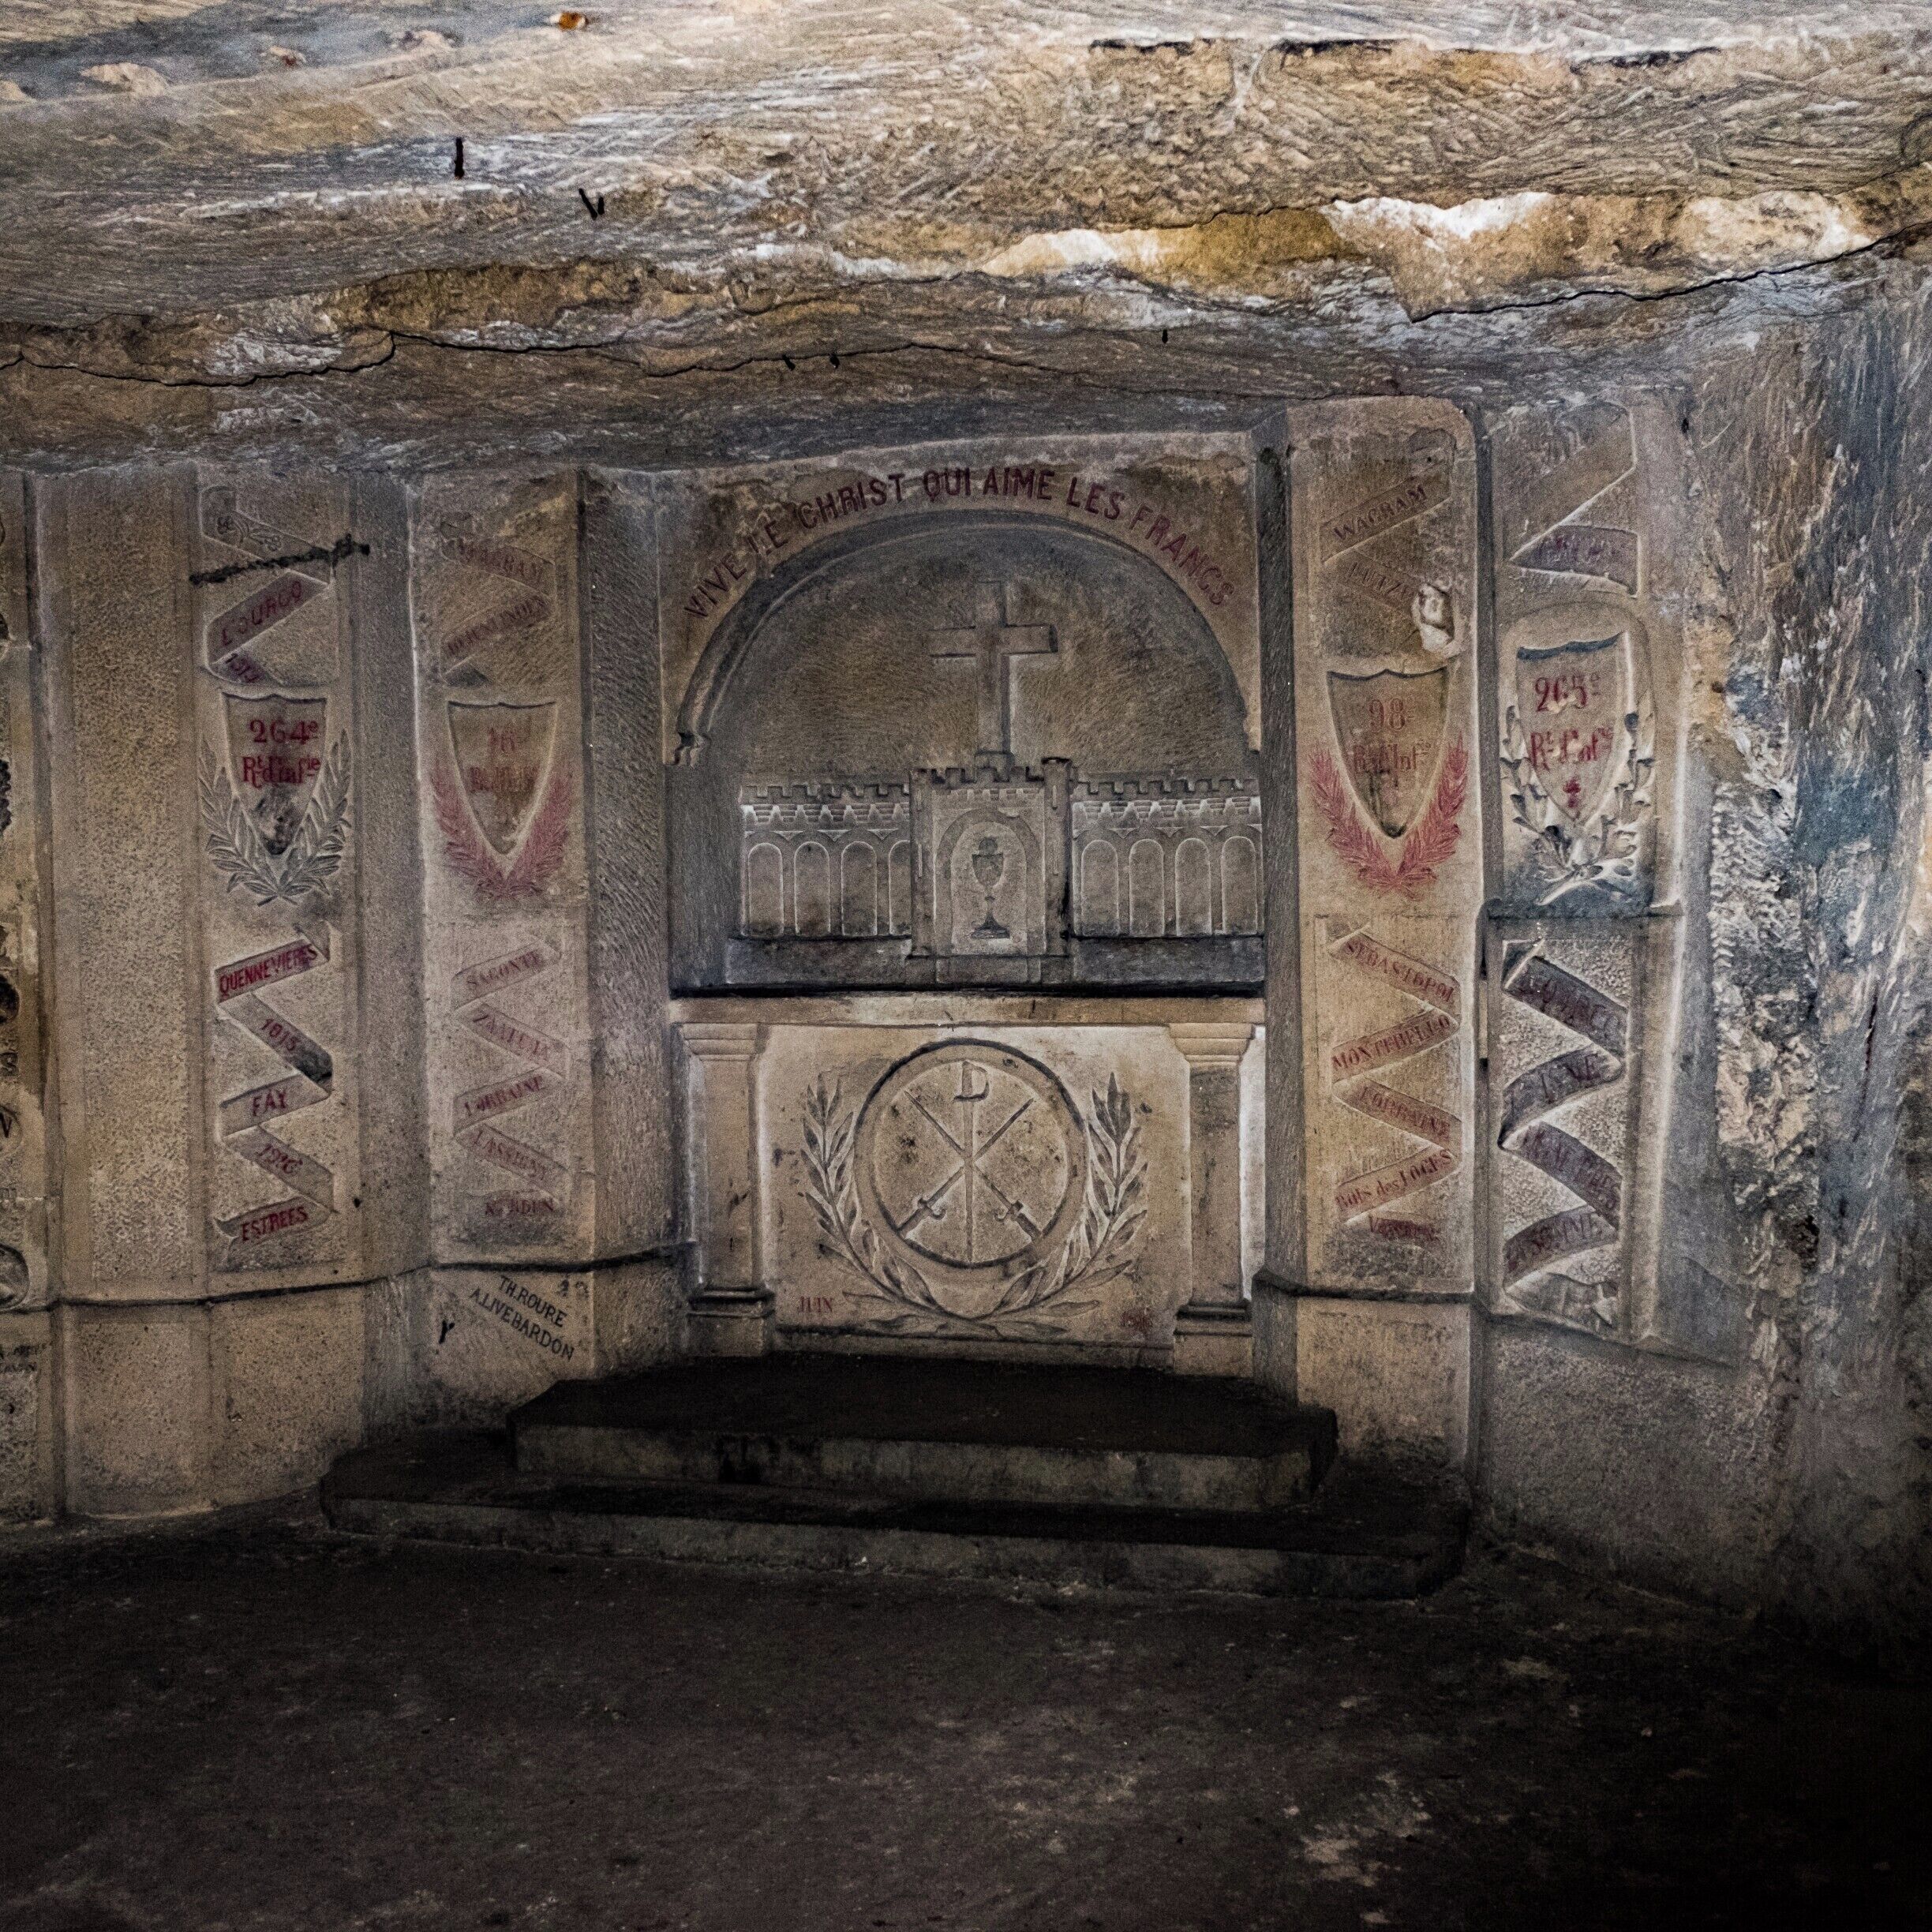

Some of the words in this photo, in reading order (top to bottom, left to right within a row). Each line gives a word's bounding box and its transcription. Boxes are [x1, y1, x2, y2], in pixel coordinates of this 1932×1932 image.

[1333, 485, 1427, 541] WAGRAM
[684, 555, 747, 618] VIVE
[748, 520, 788, 554] LE
[794, 474, 905, 529] CHRIST
[923, 467, 972, 502] QUI
[983, 467, 1056, 500] AIME
[1066, 477, 1125, 521] LES
[1128, 505, 1234, 606] FRANCS
[252, 1089, 287, 1117] FAY
